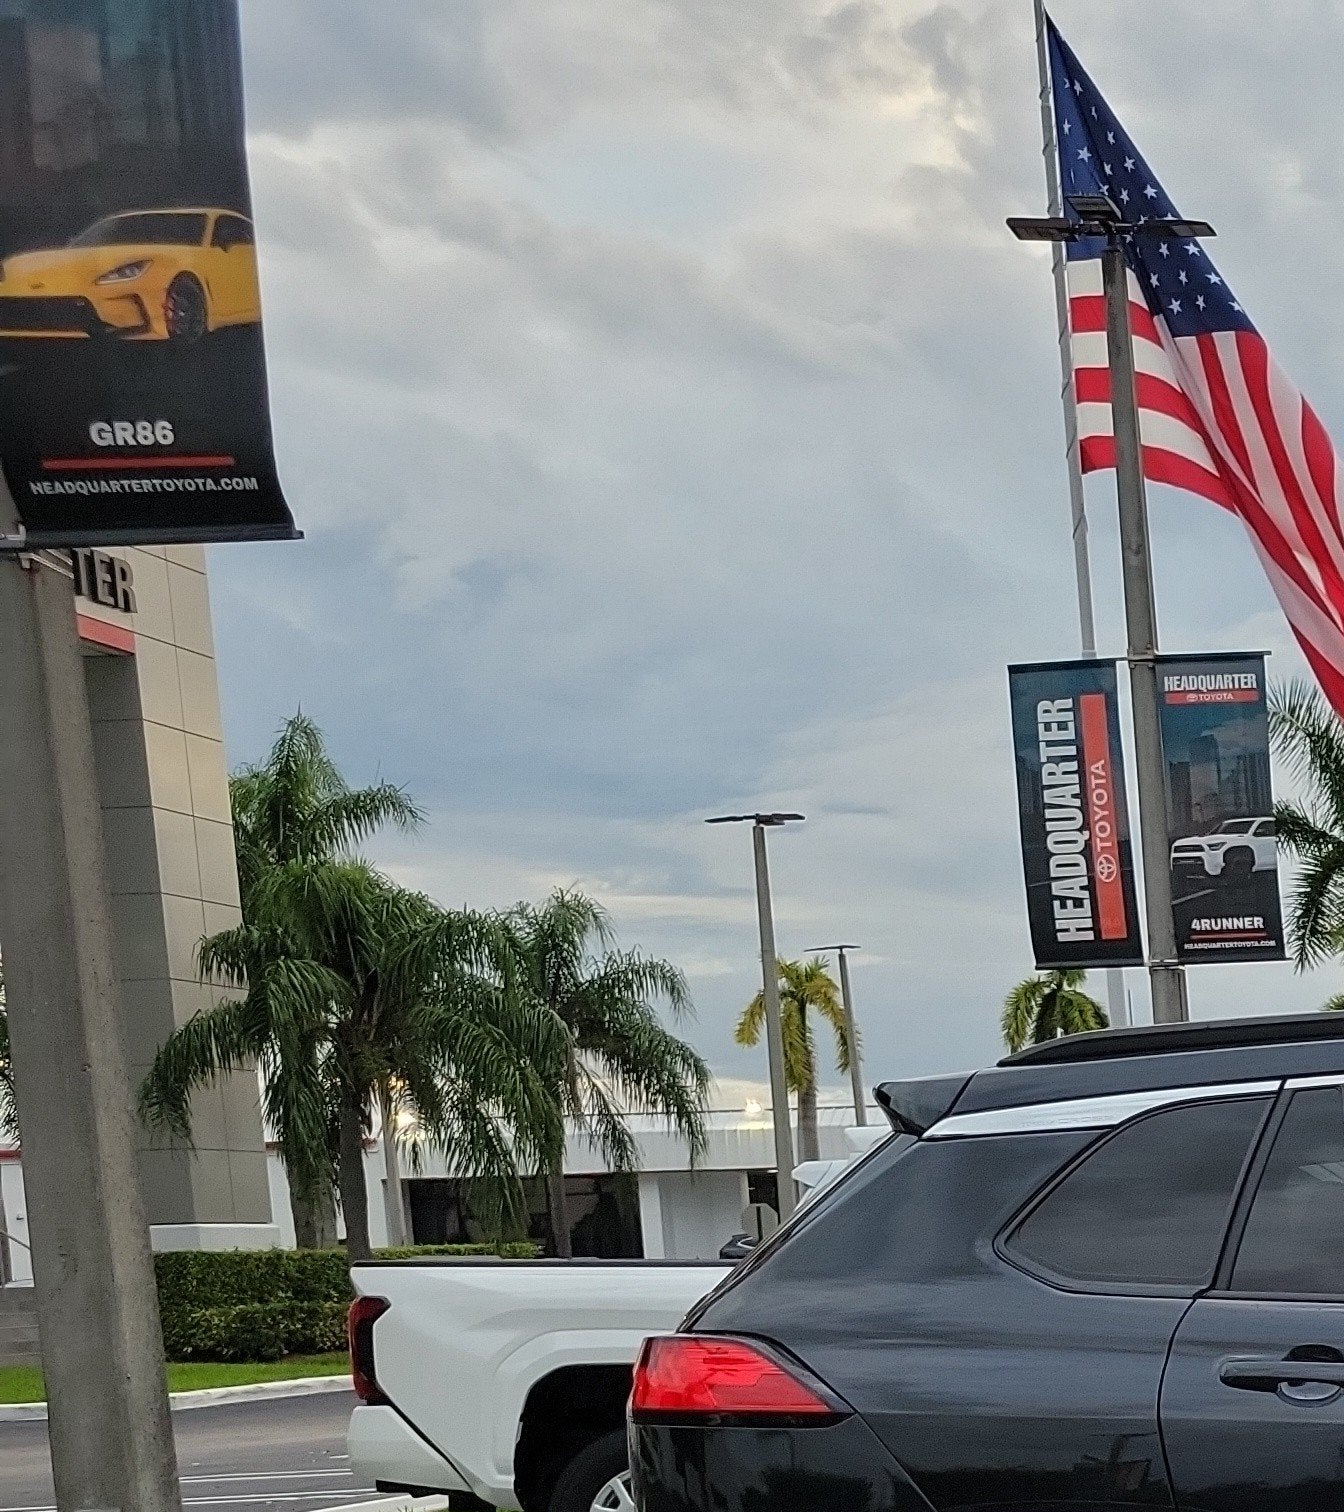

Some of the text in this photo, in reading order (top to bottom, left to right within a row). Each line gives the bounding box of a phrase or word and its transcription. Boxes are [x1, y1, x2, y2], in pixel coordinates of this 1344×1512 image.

[88, 420, 175, 447] GR86
[29, 476, 259, 496] HEADQUARTERTOYOTA.COM
[73, 547, 138, 614] TER
[1163, 673, 1258, 692] HEADQUARTER
[1199, 693, 1235, 701] TOYOTA
[1091, 759, 1113, 852] TOYOTA
[1037, 697, 1095, 942] HEADQUARTER
[1191, 916, 1265, 931] 4RUNNER
